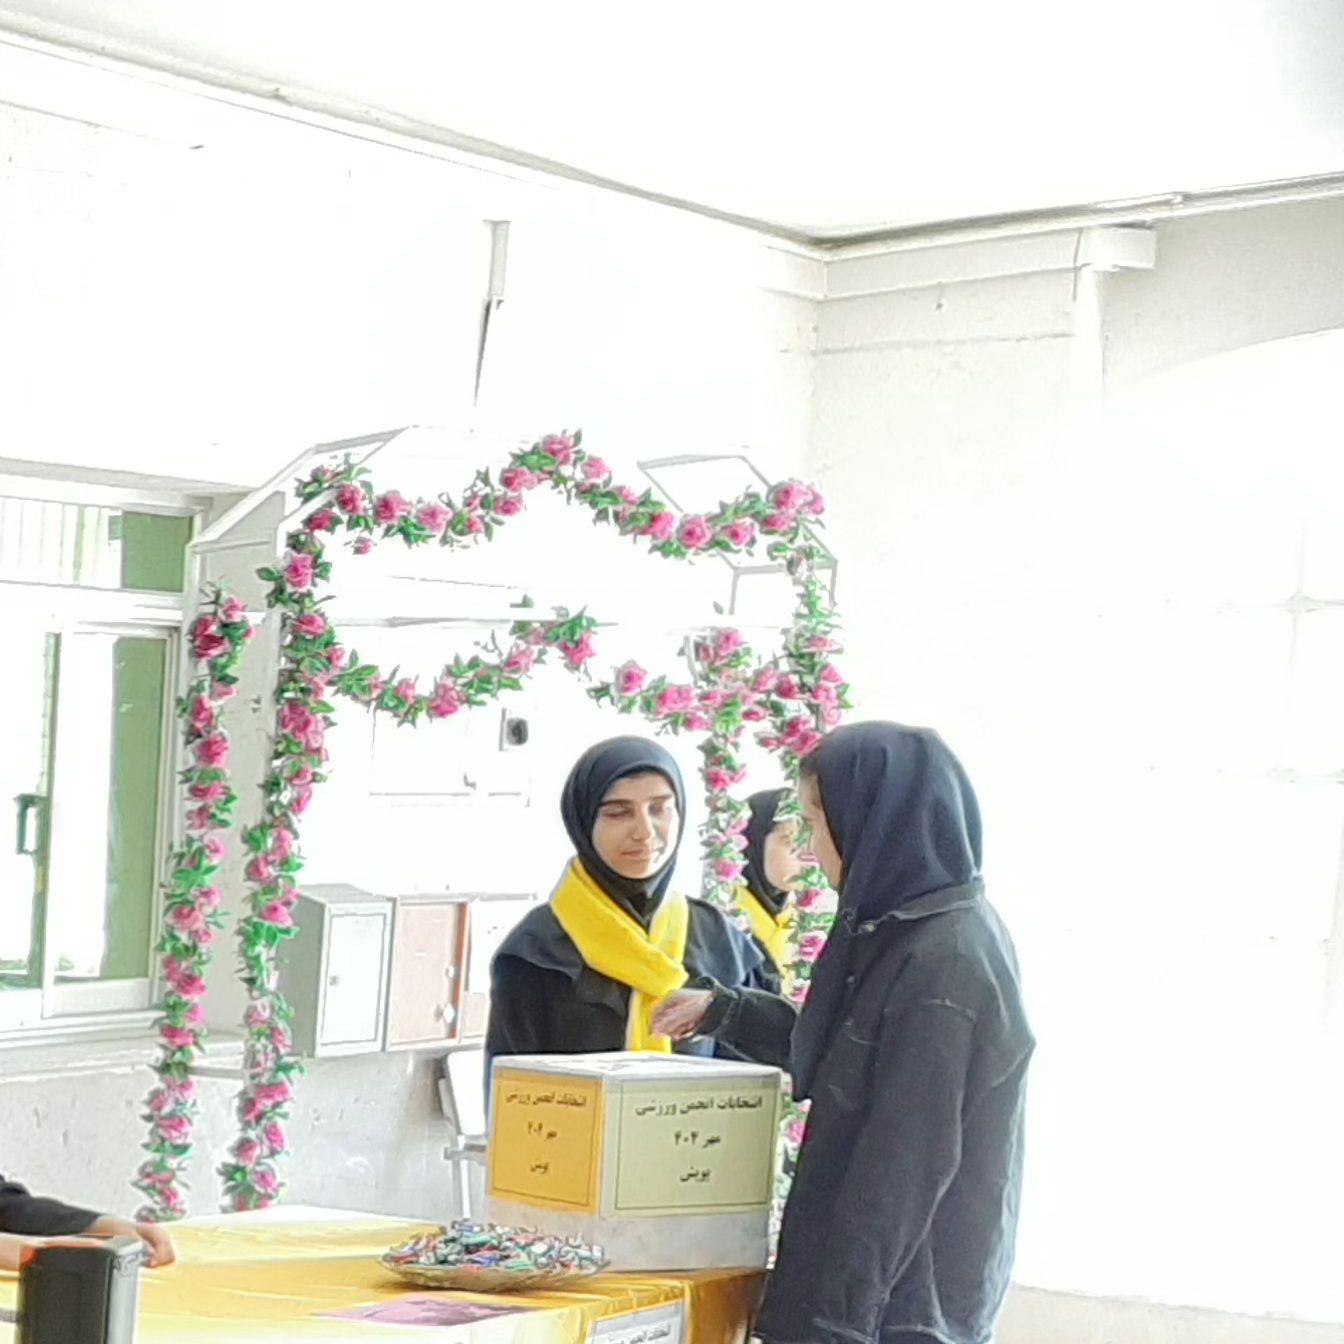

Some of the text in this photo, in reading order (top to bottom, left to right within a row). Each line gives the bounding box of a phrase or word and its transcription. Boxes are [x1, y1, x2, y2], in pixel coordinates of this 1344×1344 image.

[635, 1095, 763, 1117] انتخابات انجمن ورزشی
